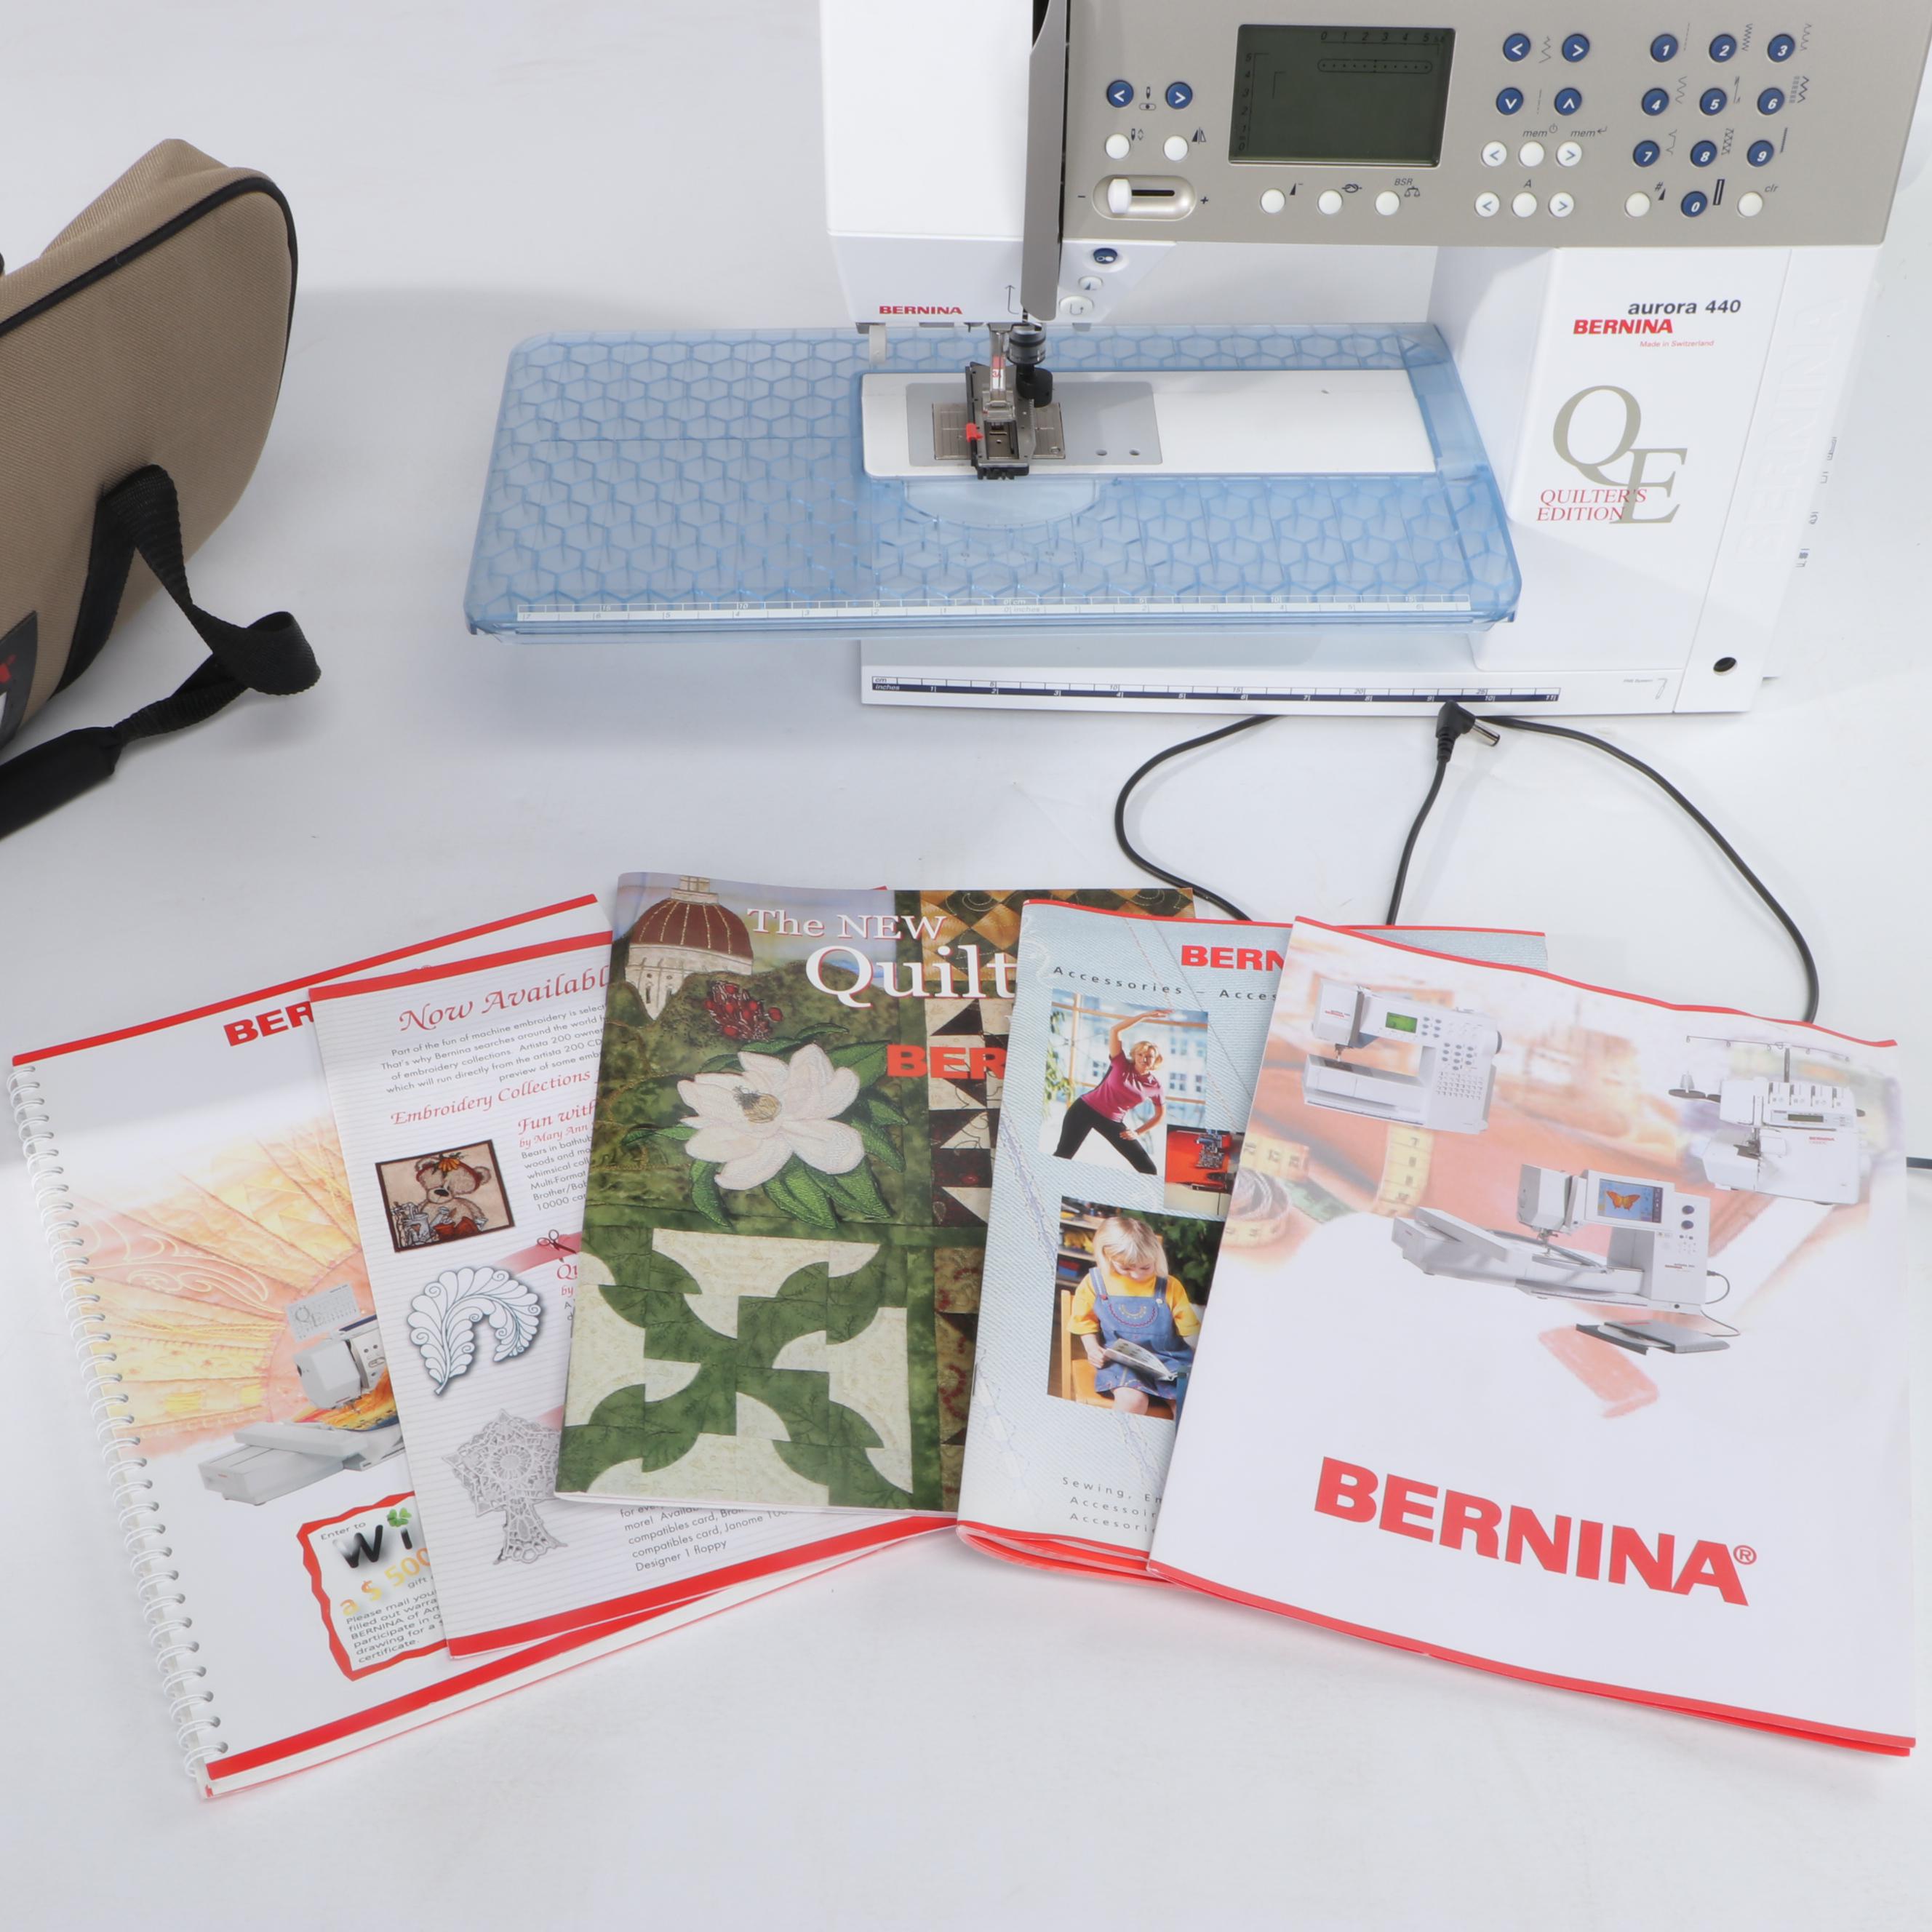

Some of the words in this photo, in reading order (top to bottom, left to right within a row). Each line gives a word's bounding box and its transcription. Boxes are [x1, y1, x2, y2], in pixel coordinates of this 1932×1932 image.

[1662, 45, 1669, 56] 1
[1720, 45, 1729, 57] 2
[1778, 45, 1787, 57] 3
[1652, 99, 1661, 111] 4
[1709, 99, 1719, 111] 5
[1768, 98, 1777, 110] 6
[1522, 129, 1548, 138] mem
[1570, 128, 1595, 138] mem
[1644, 151, 1652, 162] 7
[1700, 151, 1710, 162] 8
[1757, 151, 1767, 162] 9
[1394, 178, 1413, 187] BSR
[1523, 180, 1532, 188] A
[1764, 183, 1779, 193] clr
[1691, 201, 1700, 212] 0
[879, 306, 963, 314] BERNINA
[1627, 301, 1697, 316] aurora
[1705, 299, 1741, 314] 440
[1573, 319, 1674, 335] BERNINA
[1671, 339, 1715, 348] Switzerland
[1539, 488, 1648, 507] QUILTER'S
[1536, 506, 1626, 522] EDITION
[747, 909, 825, 937] The
[837, 914, 948, 941] NEW
[1181, 945, 1285, 971] BERN
[805, 945, 1015, 1008] Quilt
[1053, 966, 1182, 994] Accessories
[399, 1001, 473, 1031] Now
[482, 965, 609, 1013] Availabl
[223, 1001, 314, 1047] BER
[391, 1048, 410, 1057] Part
[413, 1044, 425, 1053] of
[425, 1042, 439, 1050] the
[442, 1037, 457, 1047] fun
[460, 1033, 470, 1042] of
[472, 1025, 511, 1040] machine
[514, 1013, 567, 1030] embroidery
[570, 1010, 578, 1018] is
[381, 1060, 410, 1071] That's
[412, 1056, 432, 1067] why
[435, 1047, 471, 1060] Bernina
[474, 1038, 516, 1051] searches
[517, 1026, 551, 1041] around
[553, 1023, 568, 1032] the
[570, 1016, 597, 1029] world
[391, 1072, 402, 1081] of
[403, 1063, 458, 1079] embroidery
[519, 1039, 549, 1053] Artista
[551, 1033, 572, 1044] 200
[574, 1028, 604, 1039] owner
[886, 1044, 1007, 1079] BER
[386, 1083, 415, 1094] which
[418, 1077, 434, 1088] will
[436, 1074, 452, 1084] run
[455, 1066, 490, 1081] directly
[491, 1061, 514, 1071] from
[516, 1056, 531, 1066] the
[532, 1048, 562, 1062] artista
[564, 1042, 585, 1053] 200
[587, 1037, 603, 1047] CD
[499, 1066, 537, 1082] preview
[540, 1062, 551, 1071] of
[551, 1056, 577, 1069] some
[391, 1094, 493, 1125] Embroidery
[498, 1070, 591, 1101] Collections
[518, 1115, 553, 1135] Fun
[519, 1137, 532, 1150] by
[534, 1130, 563, 1144] Mary
[565, 1124, 588, 1136] Ann
[522, 1148, 548, 1159] Bears
[524, 1156, 555, 1170] woods
[557, 1150, 575, 1161] and
[527, 1162, 571, 1180] whimsical
[530, 1170, 586, 1190] Multi-Format
[537, 1196, 569, 1211] 10000
[561, 1285, 574, 1298] by
[1063, 1477, 1131, 1499] Sewing,
[620, 1508, 636, 1519] for
[1069, 1496, 1157, 1517] Accessoir
[320, 1527, 350, 1541] Enter
[354, 1522, 366, 1530] to
[628, 1522, 690, 1545] compatibles
[692, 1513, 718, 1527] card,
[632, 1536, 693, 1558] compatibles
[695, 1526, 722, 1540] card,
[724, 1515, 764, 1533] Janome
[635, 1553, 682, 1571] Designer
[685, 1548, 690, 1557] 1
[694, 1540, 727, 1555] floppy
[407, 1576, 428, 1589] gift
[340, 1598, 361, 1617] a
[346, 1608, 382, 1624] Please
[386, 1597, 410, 1611] mail
[348, 1618, 377, 1632] filled
[380, 1610, 401, 1621] out
[351, 1618, 404, 1640] BERNINA
[407, 1611, 419, 1621] of
[354, 1622, 415, 1648] participate
[419, 1617, 429, 1626] in
[356, 1636, 404, 1656] drawing
[407, 1628, 424, 1637] for
[358, 1639, 419, 1664] certificate.
